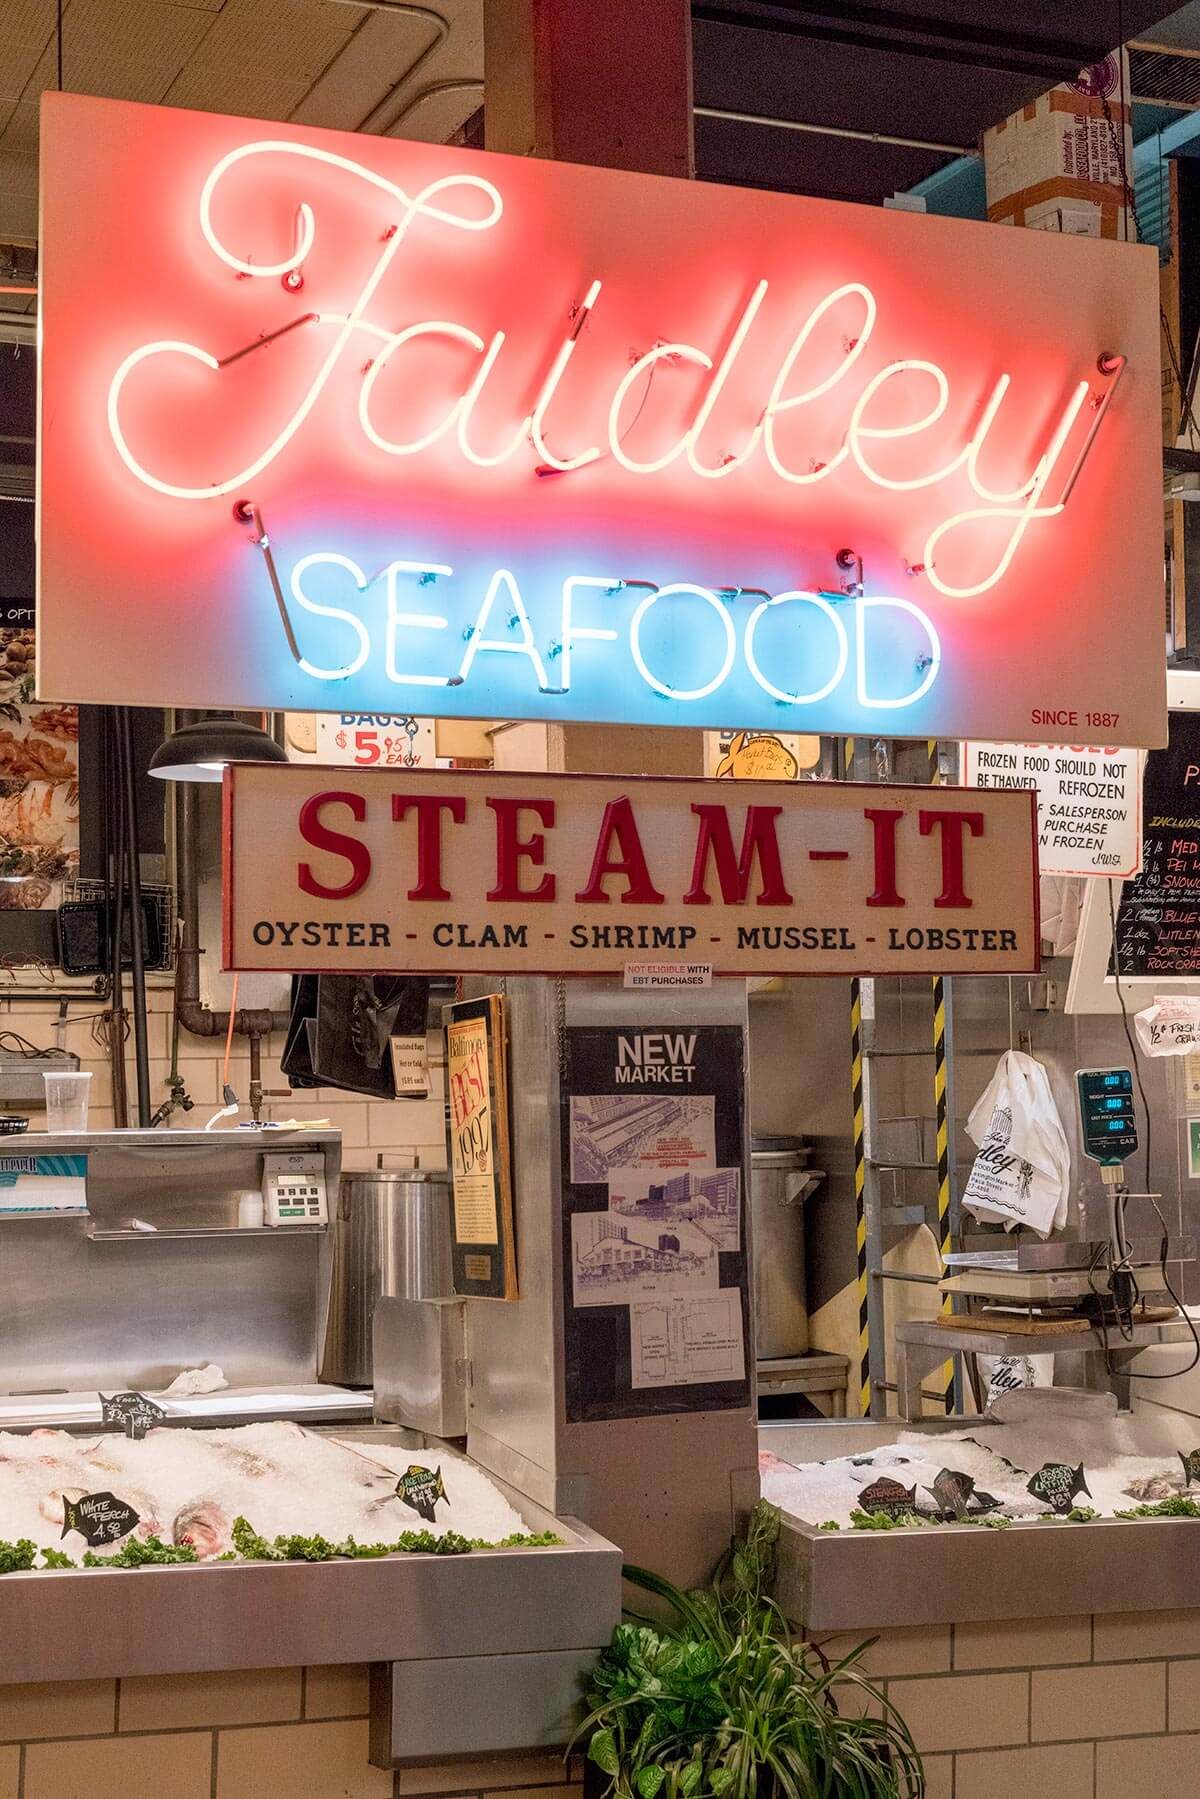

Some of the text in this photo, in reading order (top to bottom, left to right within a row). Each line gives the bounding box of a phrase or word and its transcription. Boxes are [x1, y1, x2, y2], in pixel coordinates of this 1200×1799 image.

[1090, 126, 1100, 160] MARYLAND
[1075, 140, 1089, 172] SEAFOOD
[107, 139, 1089, 598] Faidley
[290, 552, 942, 709] SEAFOOD
[1031, 709, 1120, 728] SINCE 1887
[977, 751, 1127, 779] FROZEN FOOD SHOULD NOT
[992, 774, 1037, 789] THAWED
[1059, 780, 1125, 799] REFROZEN
[1049, 804, 1127, 821] SALESPERSON
[1043, 820, 1108, 834] PURCHASE
[298, 791, 985, 908] STEAM-IT
[1052, 835, 1104, 850] FROZEN
[1171, 840, 1198, 857] MED
[1160, 909, 1198, 923] BLUE
[253, 921, 391, 947] OYSTER
[432, 923, 528, 948] CLAM
[569, 924, 697, 949] SHRIMP
[737, 926, 855, 950] MUSSEL
[888, 928, 1018, 951] LOBSTER
[628, 966, 710, 974] NOT ELIGIBLE WITH
[1123, 960, 1134, 971] 2
[632, 976, 704, 985] EBT PURCHASES
[617, 1033, 697, 1066] NEW
[615, 1065, 696, 1083] MARKET
[80, 1499, 111, 1517] WHITE
[87, 1510, 130, 1523] PERCH
